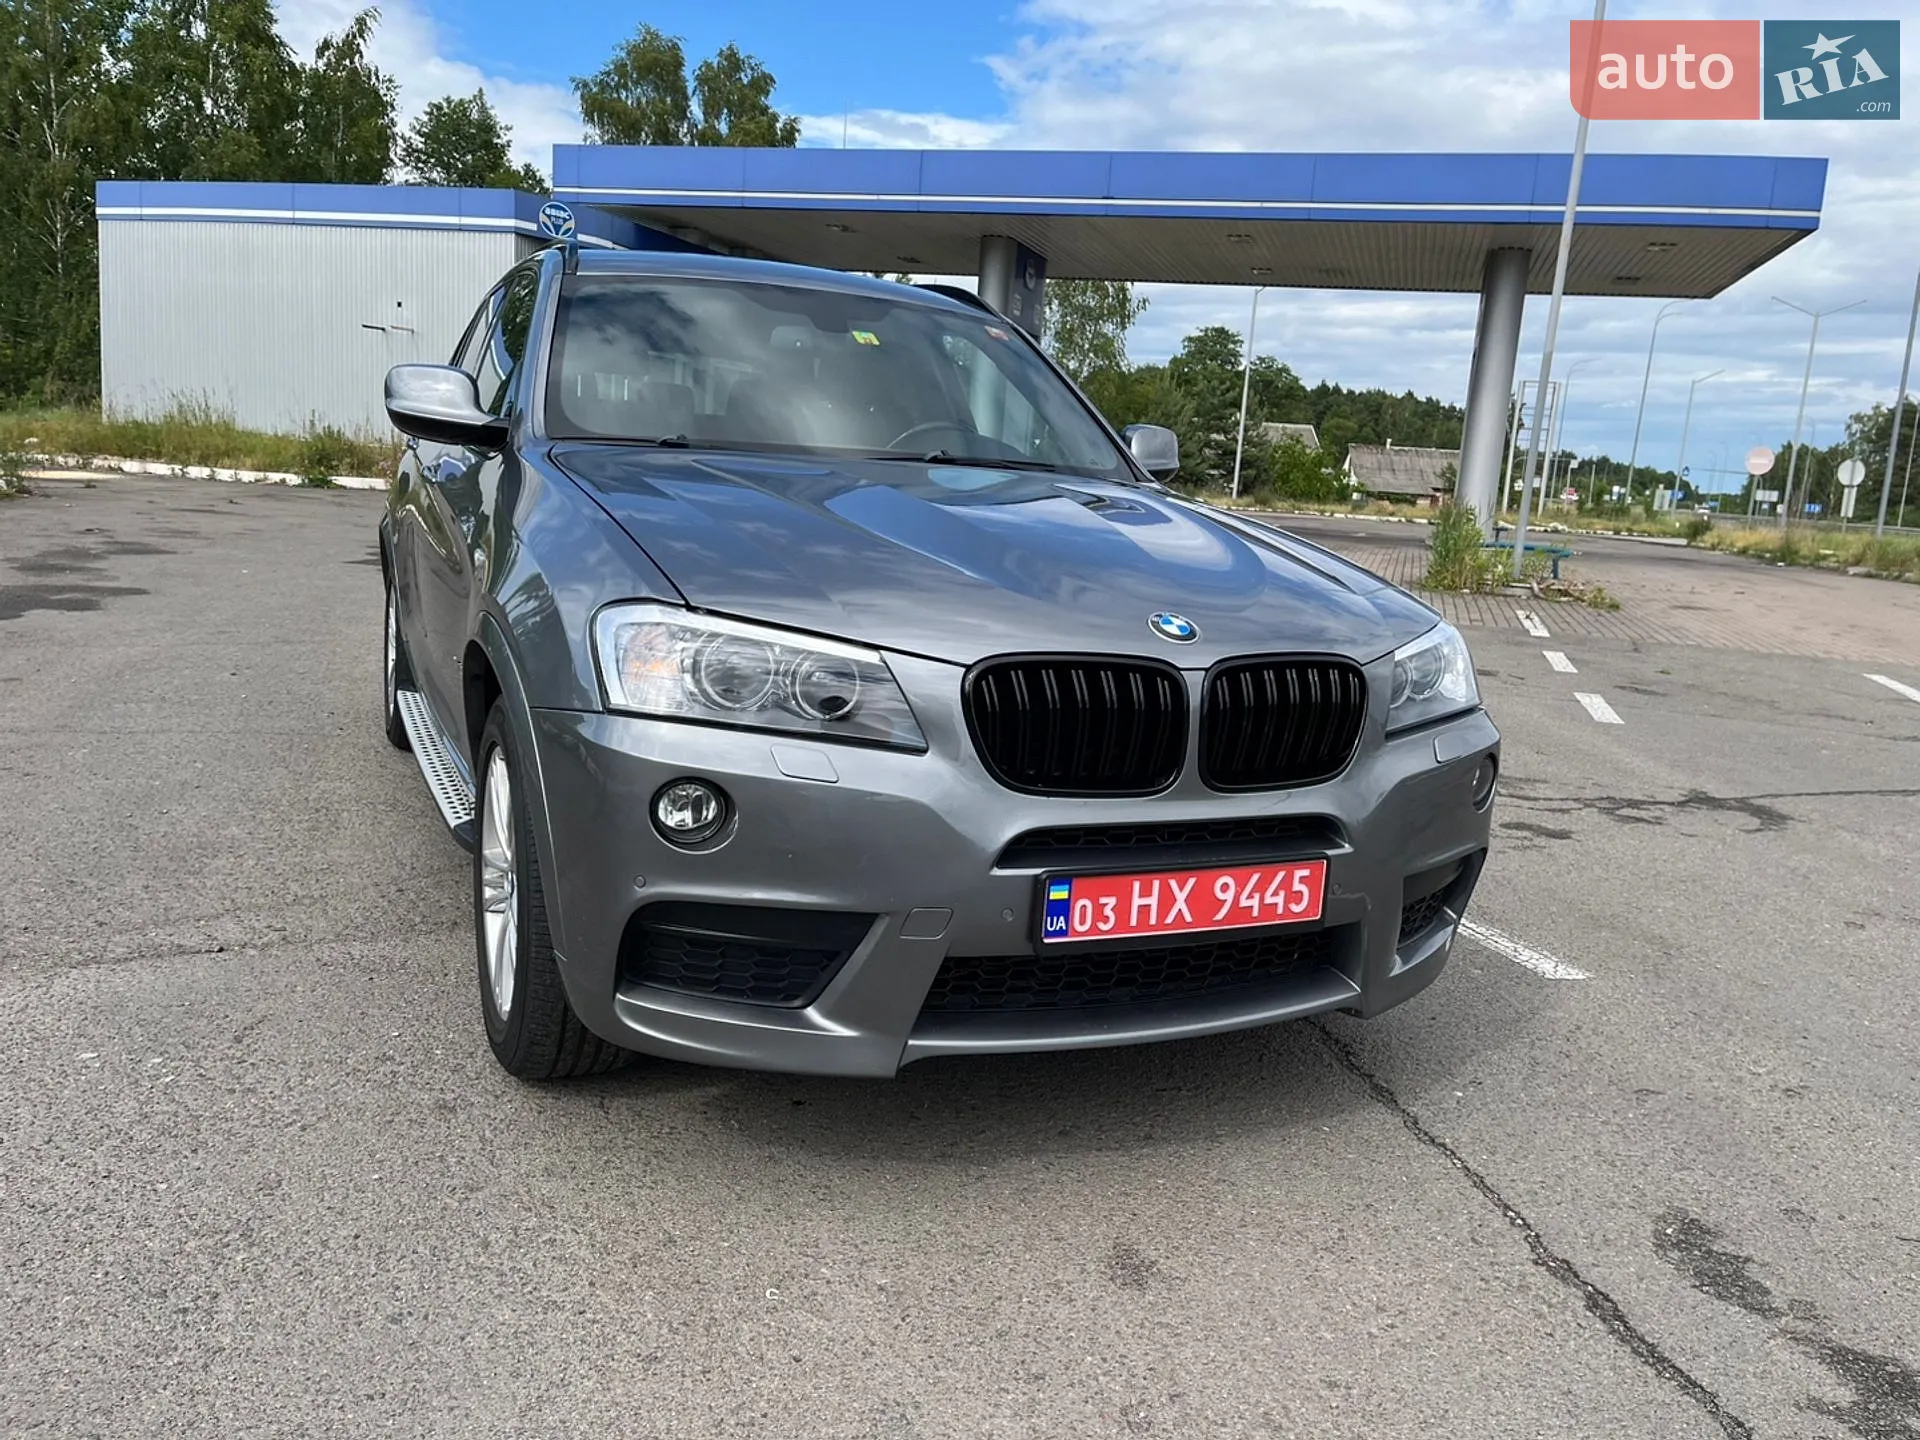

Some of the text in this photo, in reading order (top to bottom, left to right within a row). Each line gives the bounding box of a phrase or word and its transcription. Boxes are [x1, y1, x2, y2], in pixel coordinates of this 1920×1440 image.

[1072, 869, 1311, 933] 03 HX 9445
[1046, 916, 1067, 931] UA
